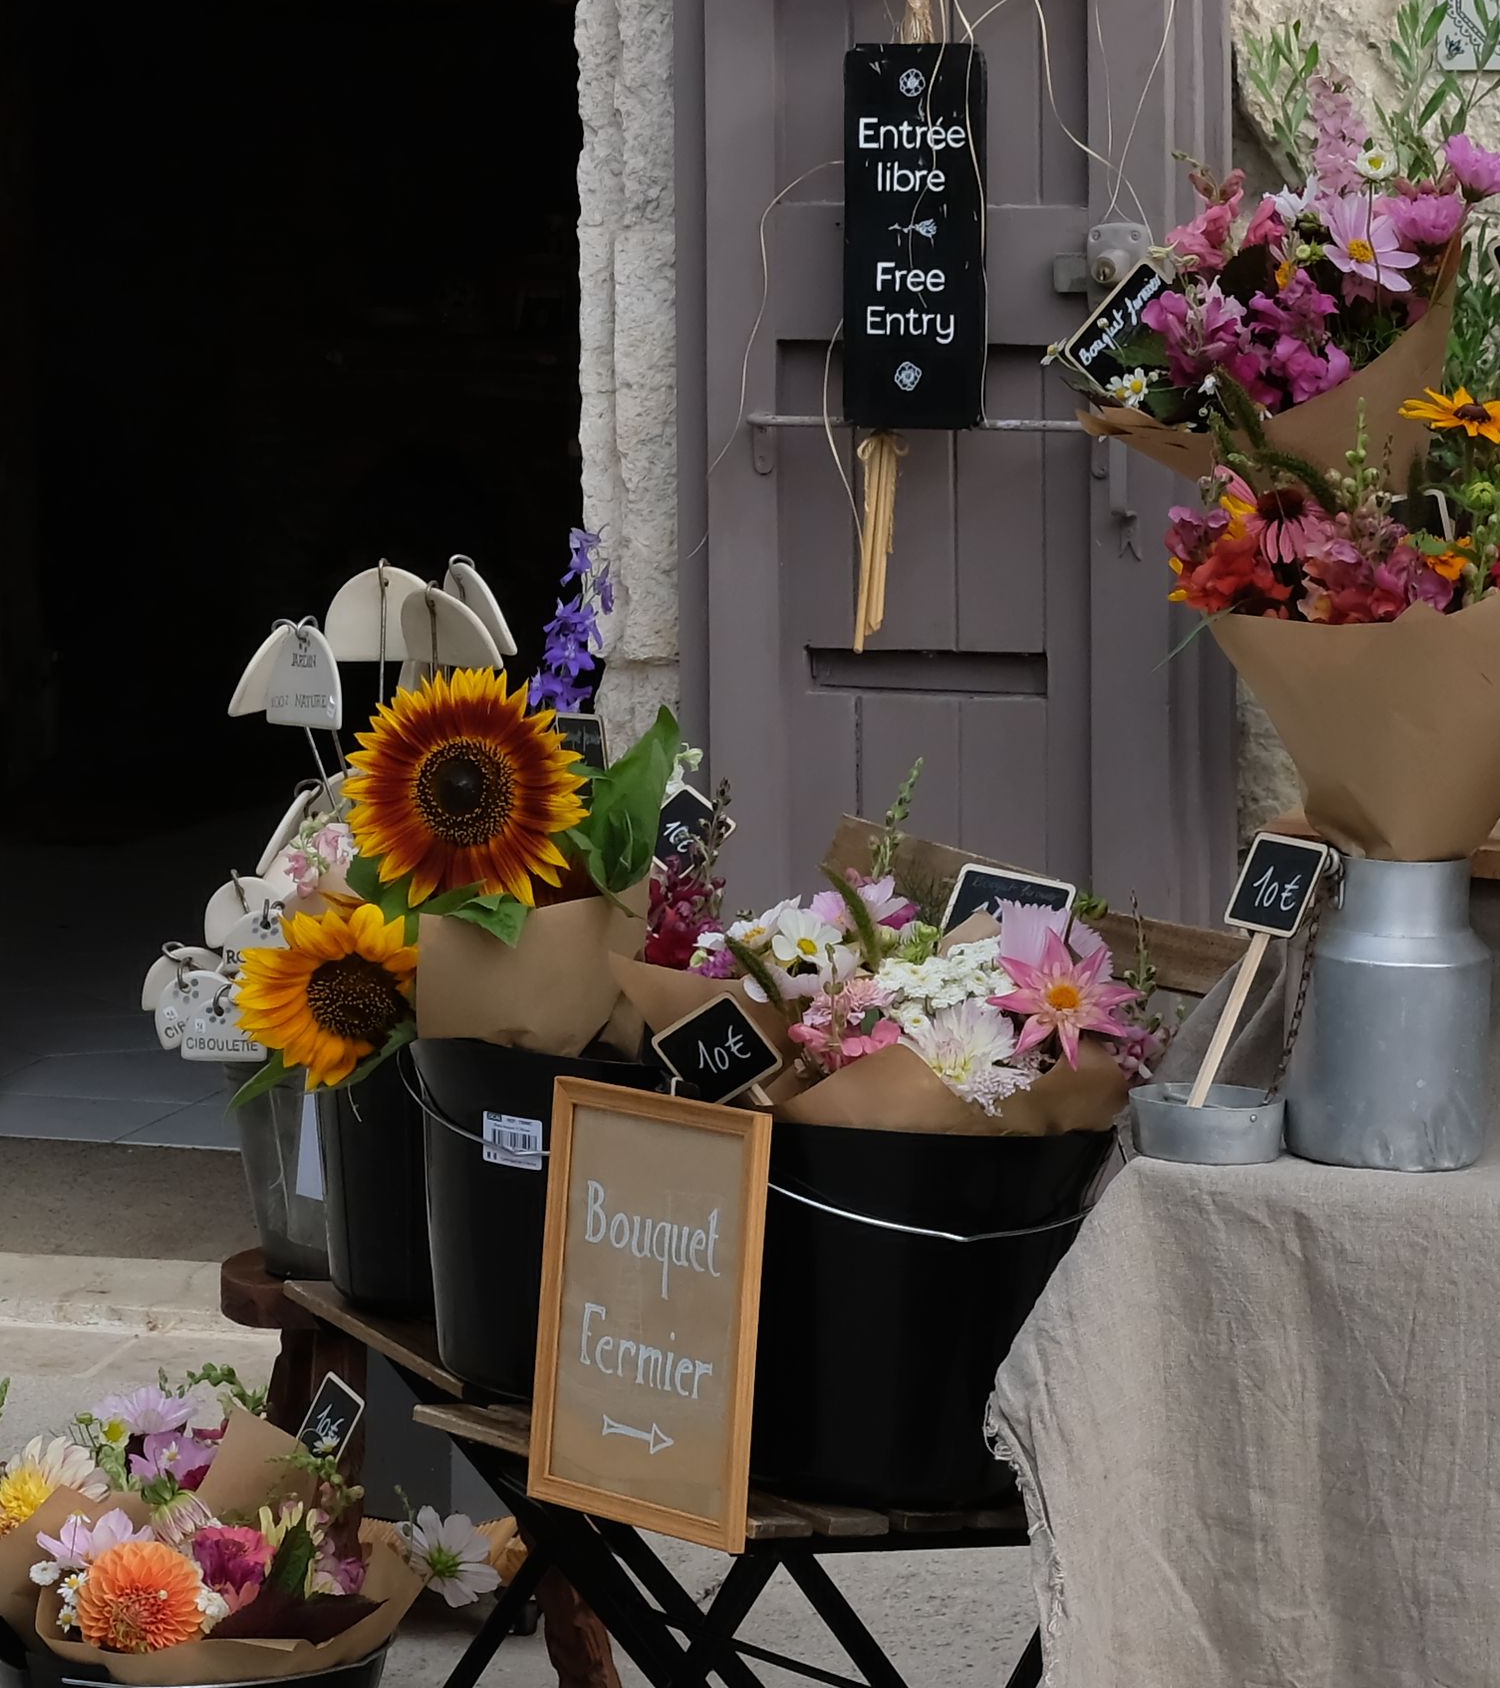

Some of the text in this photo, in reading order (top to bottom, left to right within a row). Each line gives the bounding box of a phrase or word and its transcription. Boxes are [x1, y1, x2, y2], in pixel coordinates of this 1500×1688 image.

[858, 116, 966, 150] Entrée
[876, 161, 946, 193] libre
[875, 262, 945, 293] Free
[866, 305, 955, 345] Entry
[1253, 866, 1302, 911] 10€
[697, 1025, 752, 1074] 10€
[584, 1179, 721, 1300] Bouquet
[579, 1302, 714, 1400] Fermier
